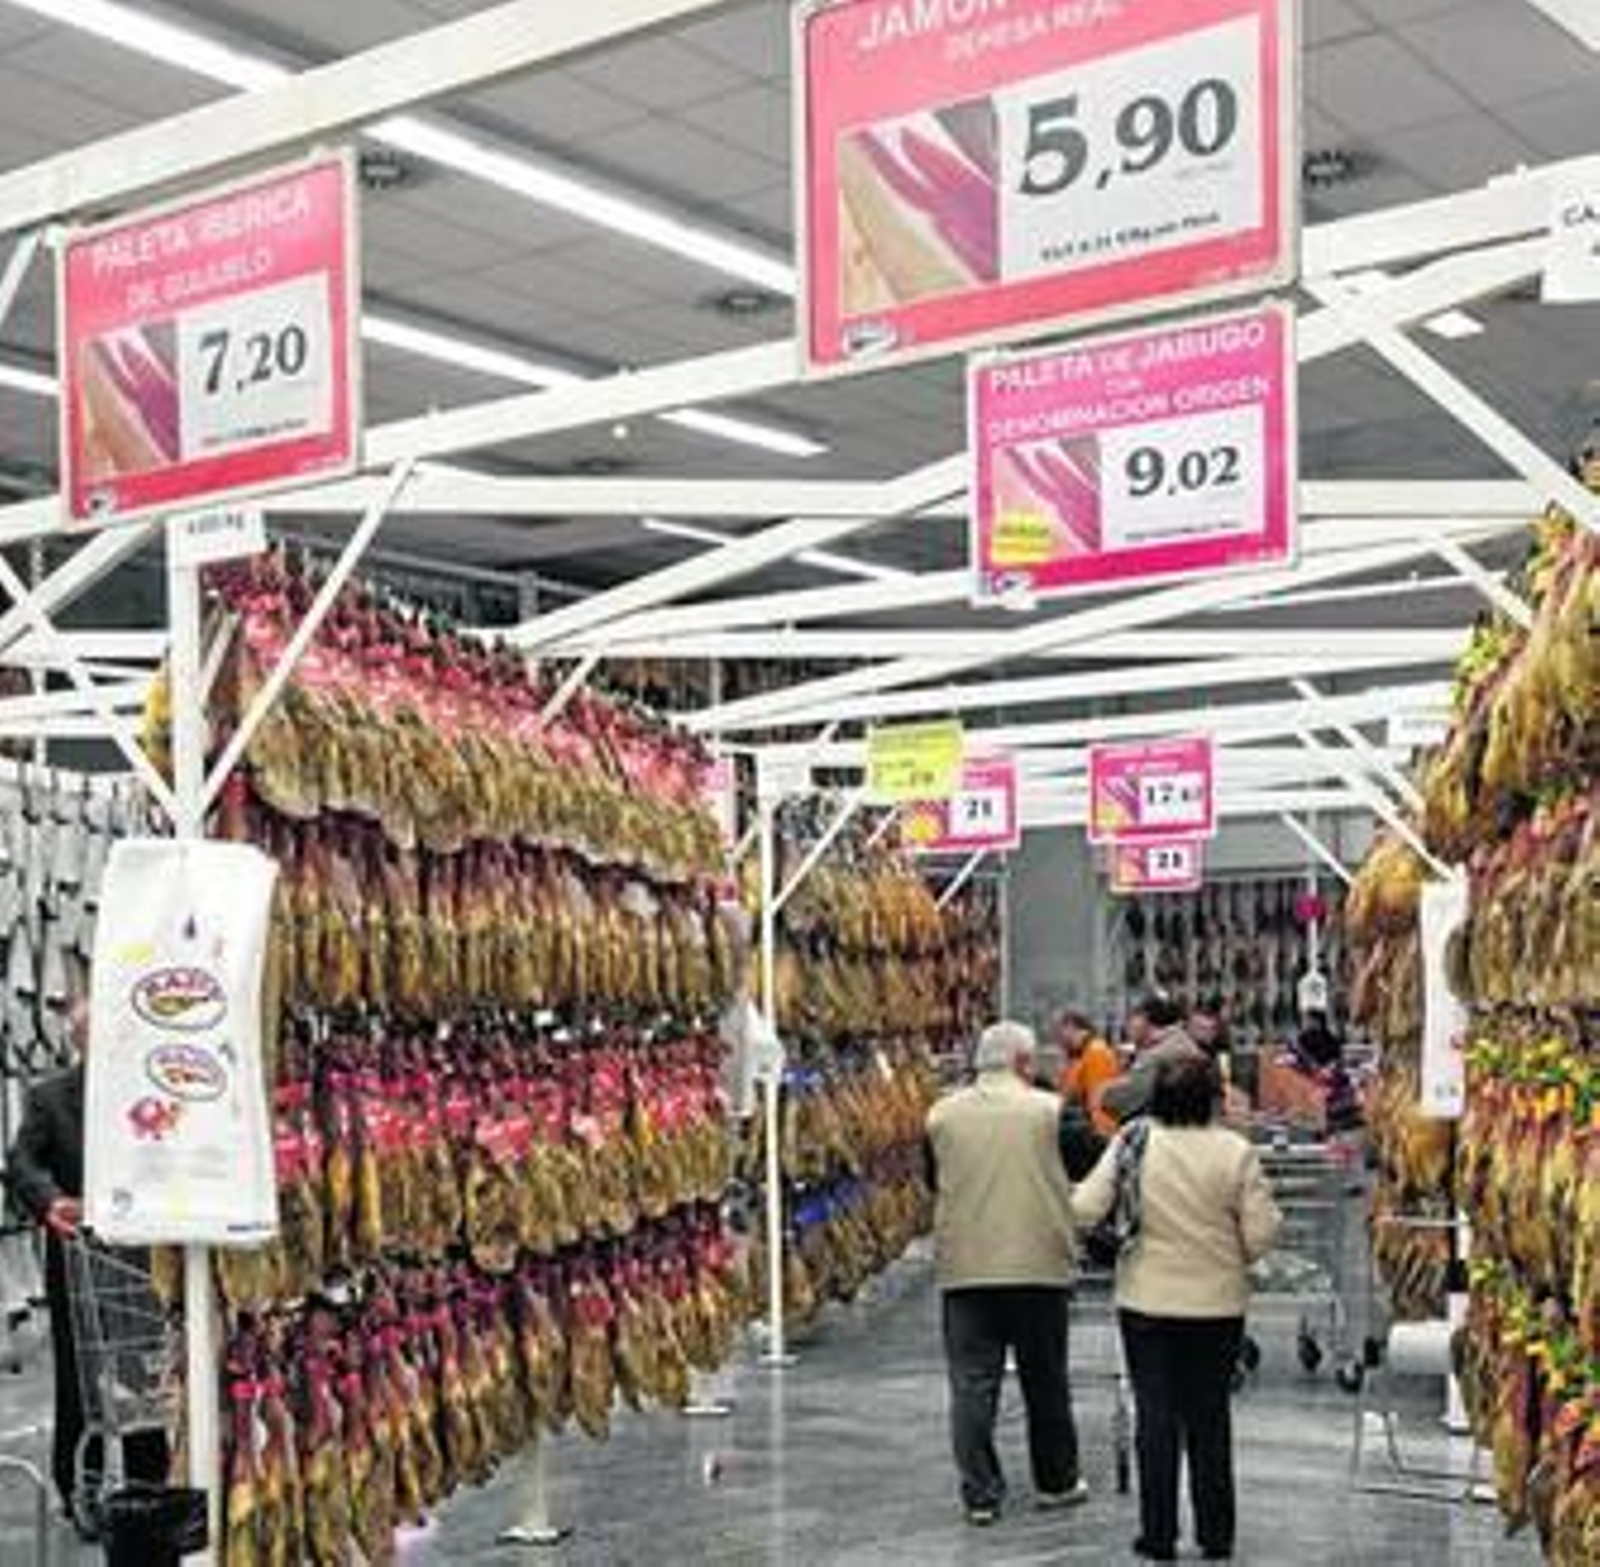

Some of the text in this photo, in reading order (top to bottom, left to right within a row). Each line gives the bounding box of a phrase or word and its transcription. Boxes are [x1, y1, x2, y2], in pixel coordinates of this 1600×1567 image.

[1016, 78, 1238, 197] 5,90
[92, 222, 190, 278] PALETA
[990, 322, 1265, 393] PALETA DE JABUGO
